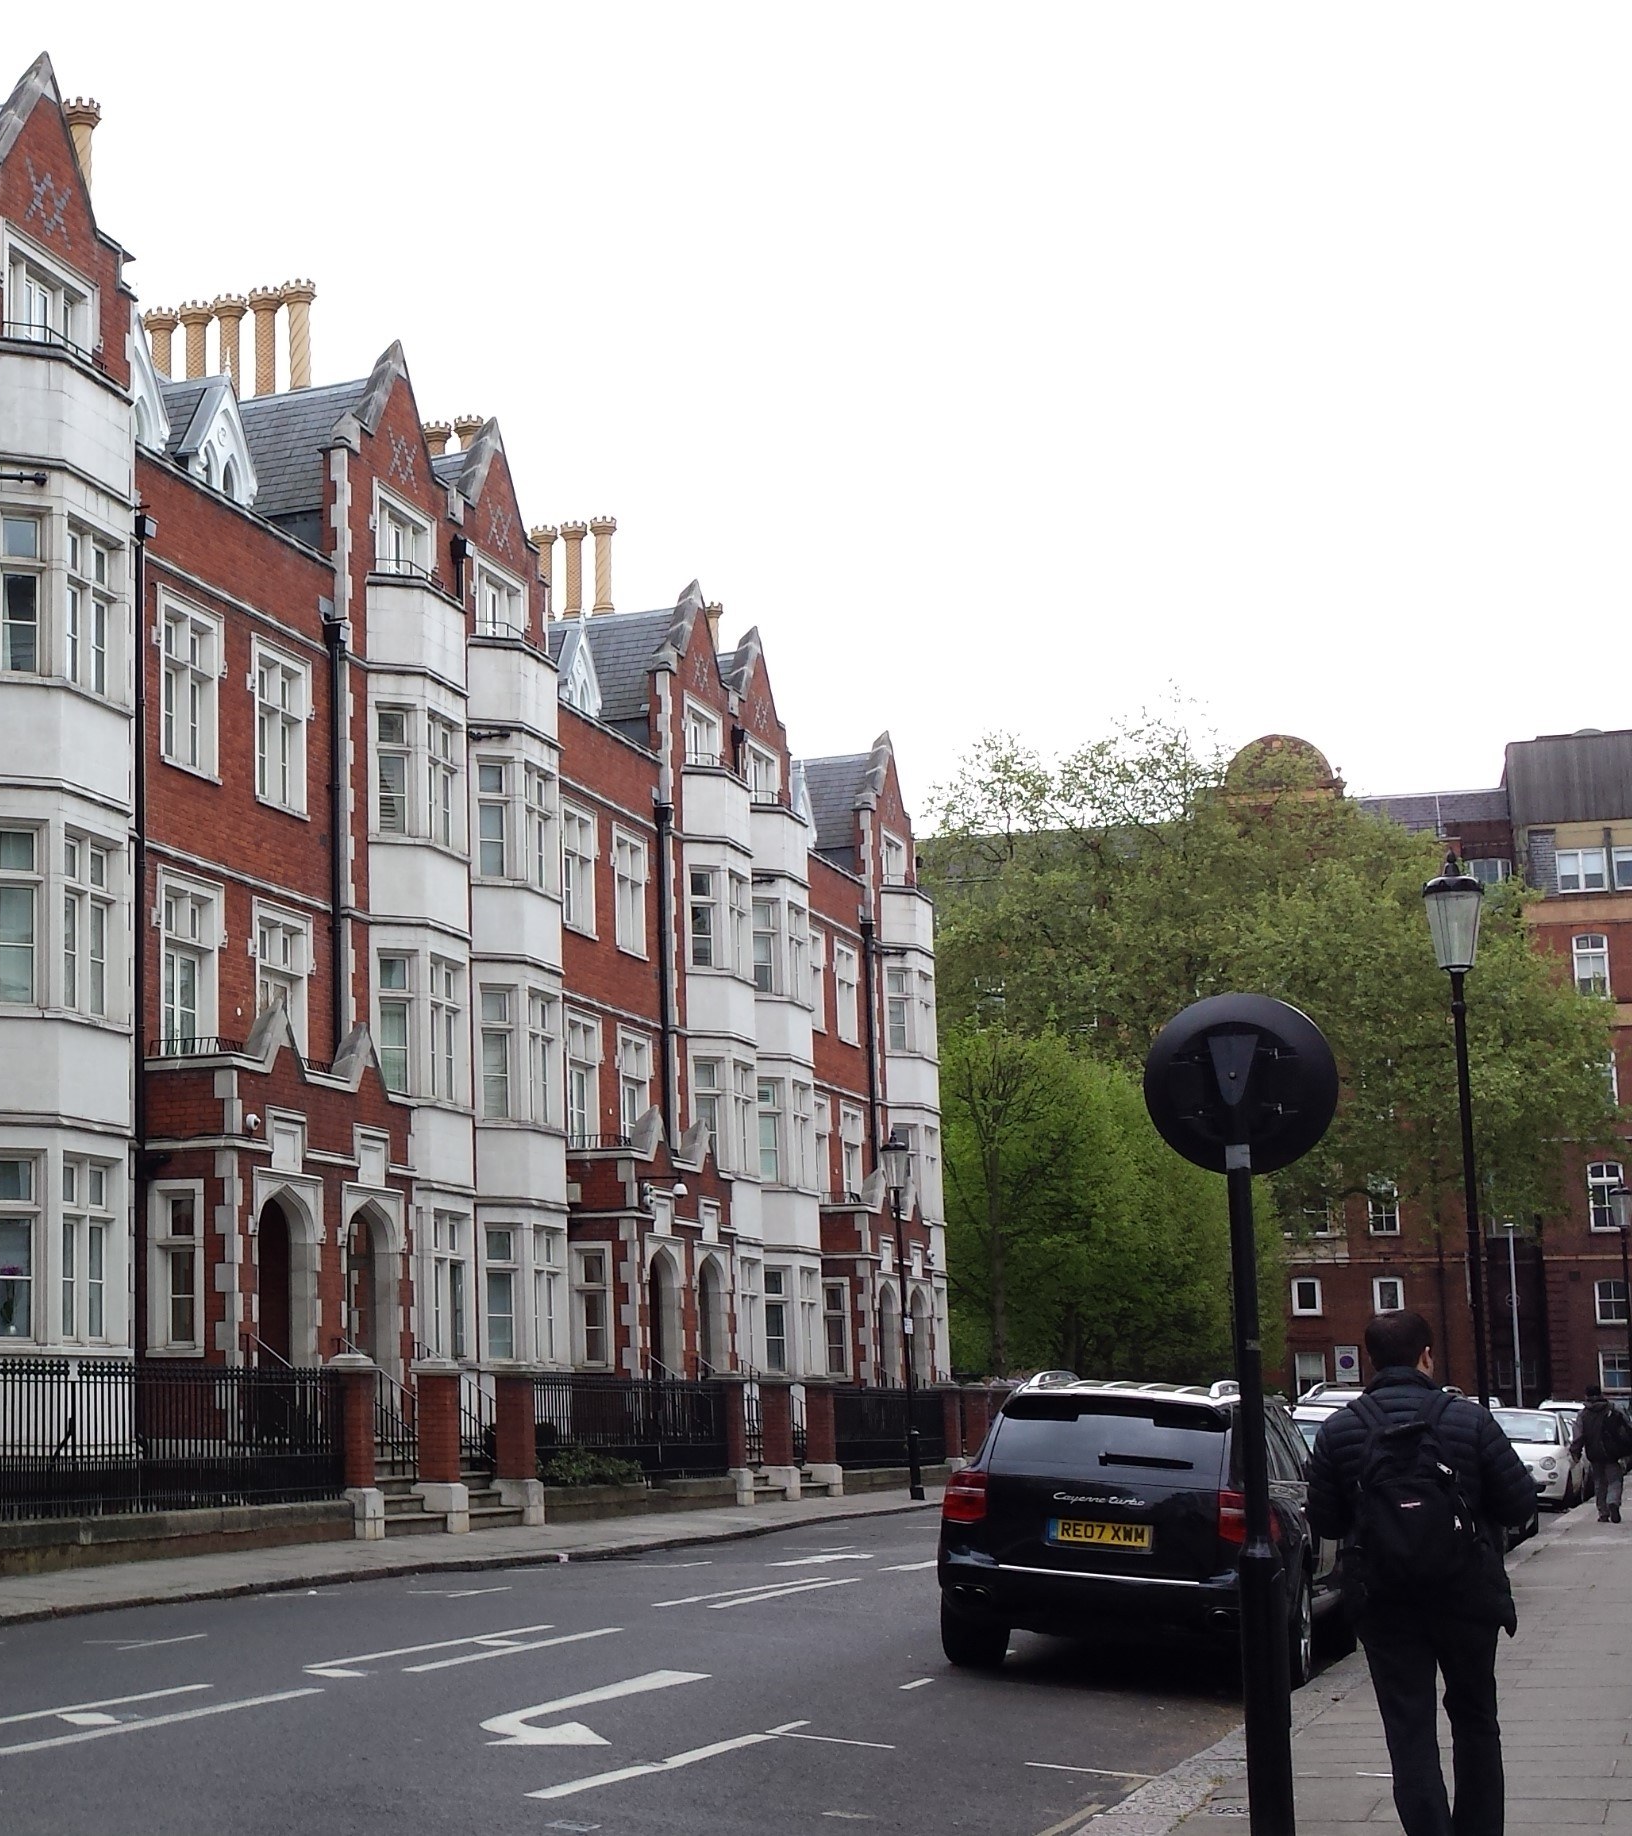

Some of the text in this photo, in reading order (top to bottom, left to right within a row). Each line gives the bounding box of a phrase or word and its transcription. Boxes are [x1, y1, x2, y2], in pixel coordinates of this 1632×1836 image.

[1053, 1492, 1146, 1506] Cayenne turbo
[1061, 1522, 1145, 1542] RE07 XWM
